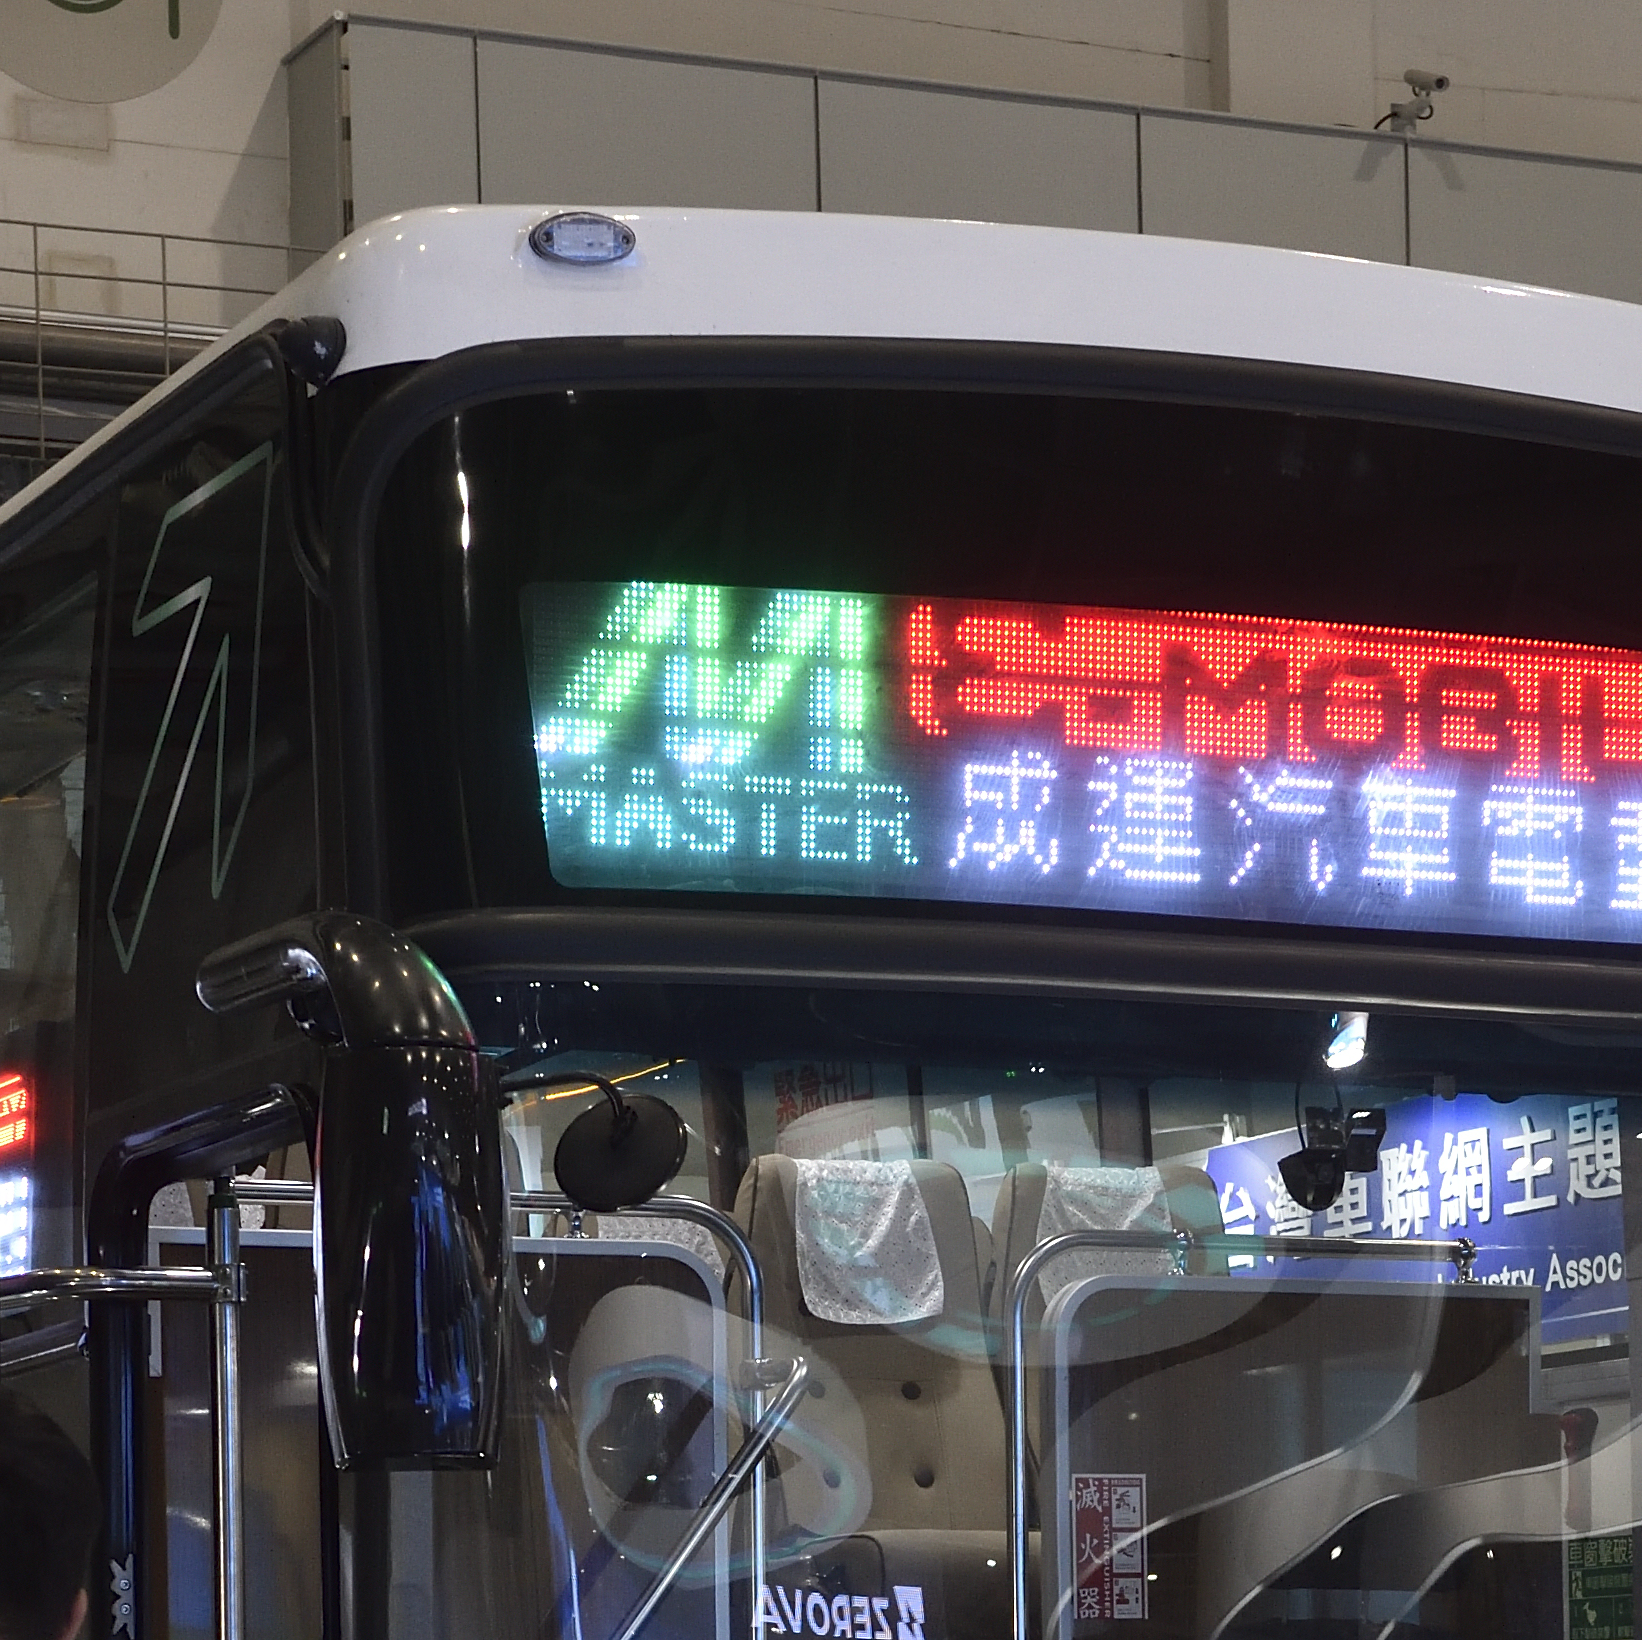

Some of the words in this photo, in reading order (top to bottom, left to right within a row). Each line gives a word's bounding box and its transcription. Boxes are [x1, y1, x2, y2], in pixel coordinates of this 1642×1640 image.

[541, 762, 919, 866] MASTER
[1077, 1478, 1102, 1619] 滅火器
